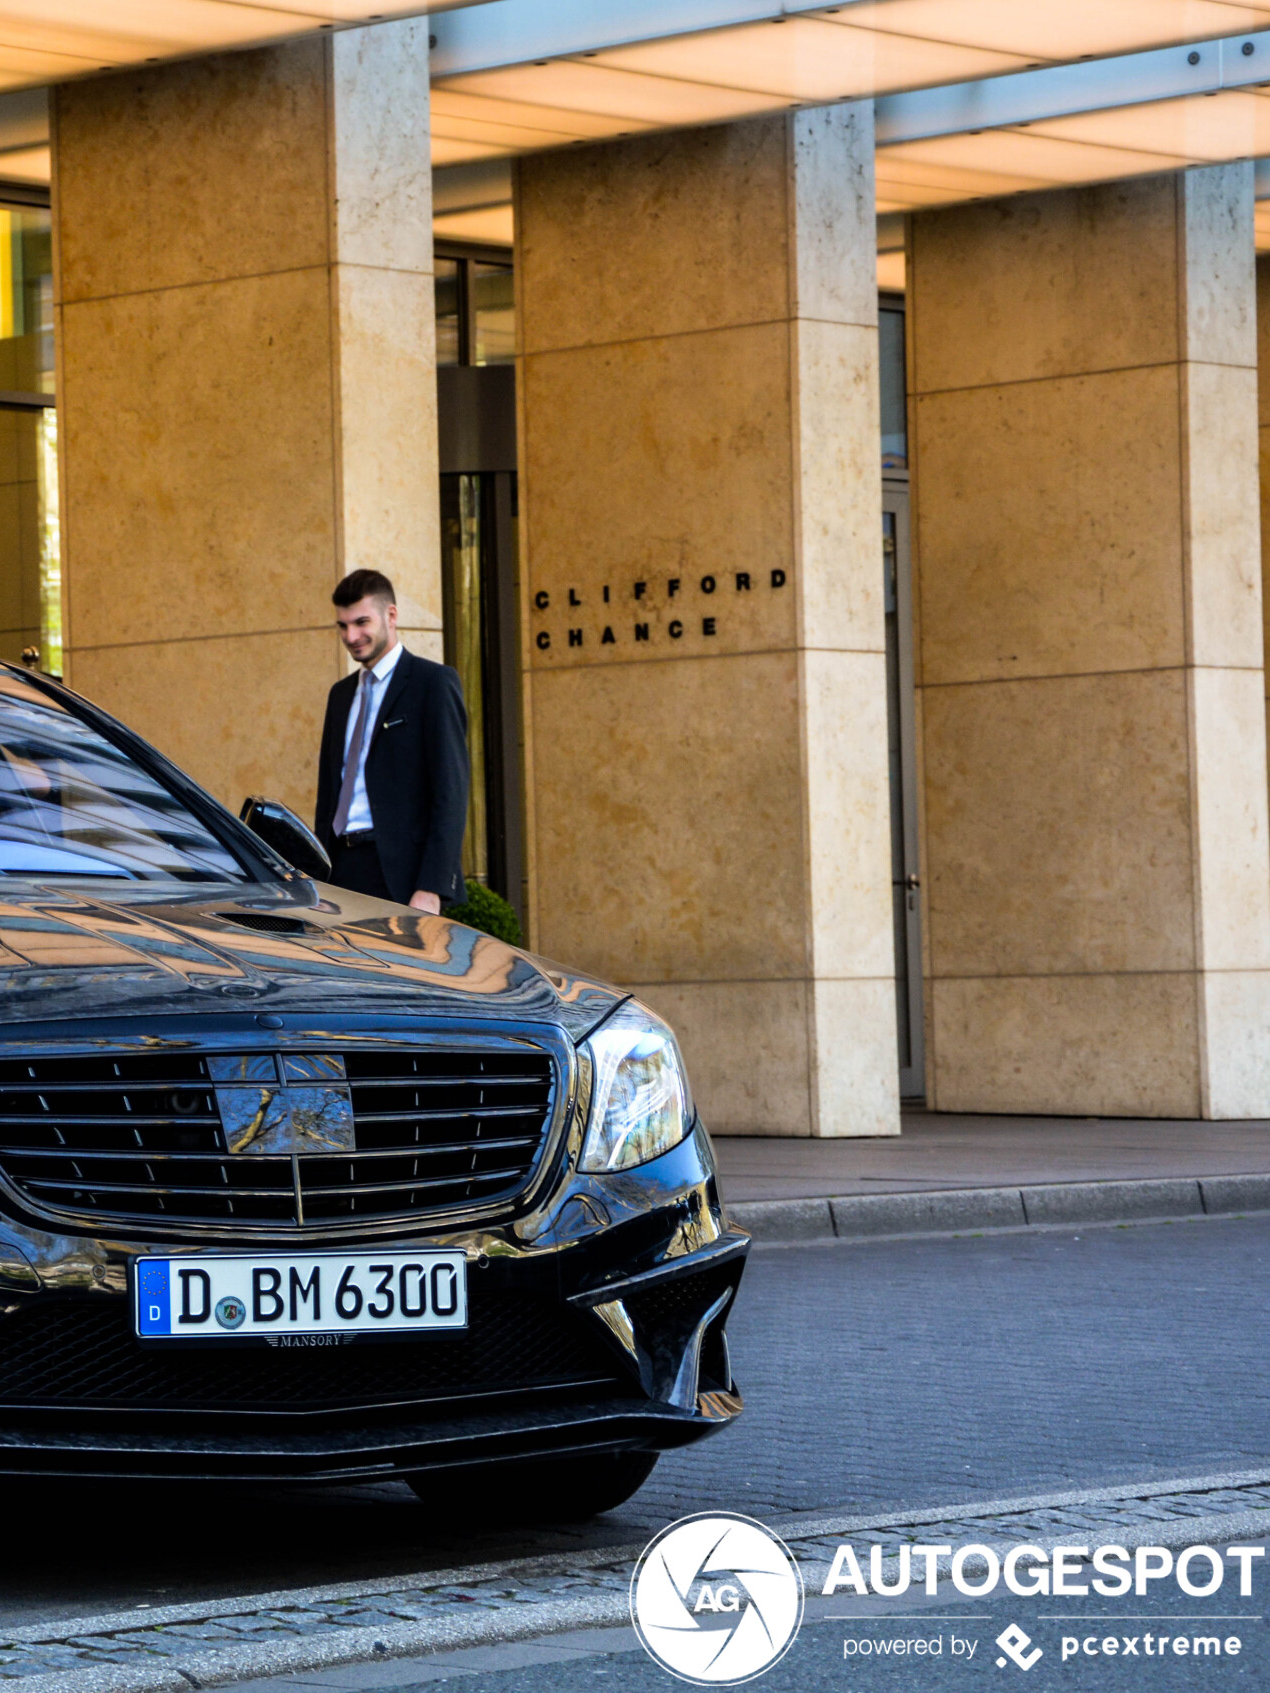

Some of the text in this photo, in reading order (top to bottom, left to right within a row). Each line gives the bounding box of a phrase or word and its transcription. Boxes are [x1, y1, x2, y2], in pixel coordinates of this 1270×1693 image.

[535, 569, 786, 609] CLIFFORD
[536, 617, 716, 650] CHANCE
[178, 1268, 211, 1324] D
[252, 1264, 321, 1322] BM
[335, 1262, 458, 1320] 6300
[149, 1305, 161, 1321] D
[280, 1334, 341, 1347] MANSORY
